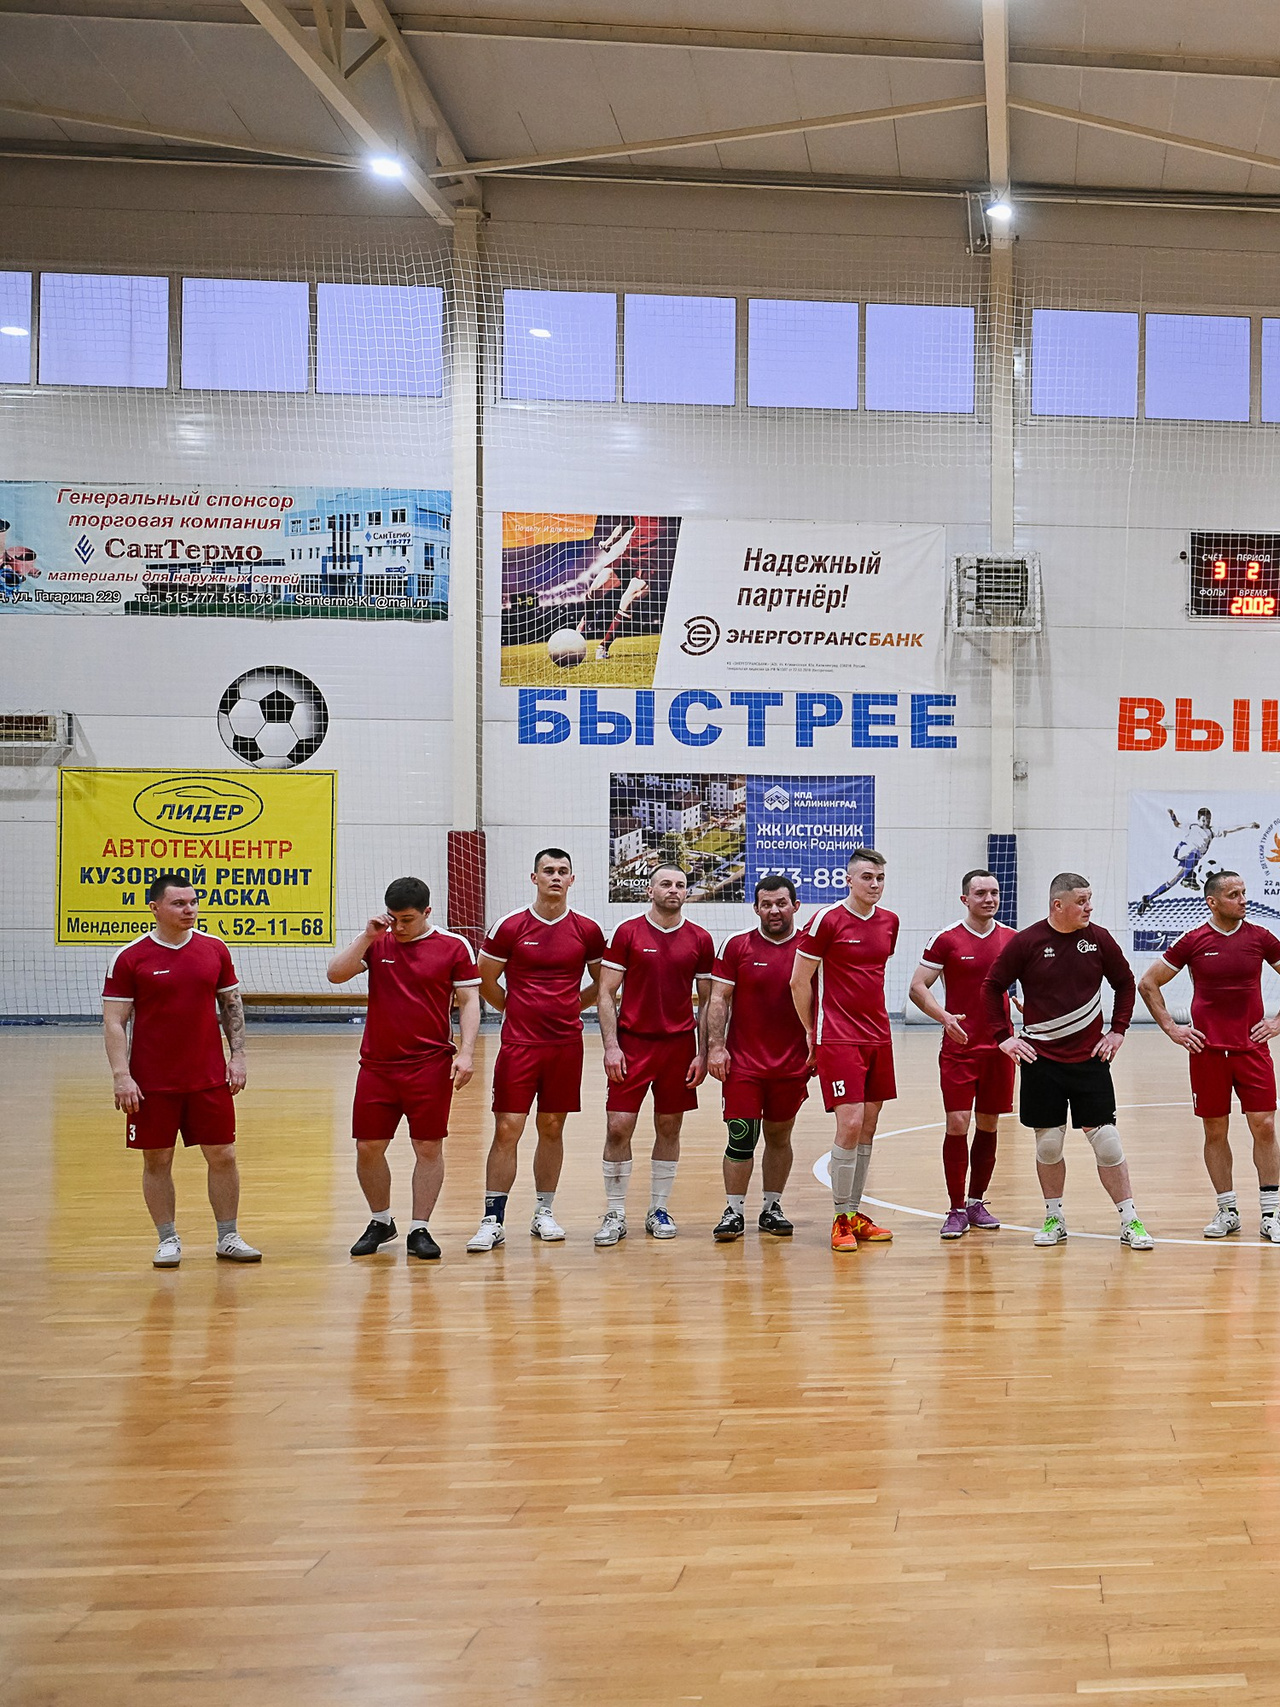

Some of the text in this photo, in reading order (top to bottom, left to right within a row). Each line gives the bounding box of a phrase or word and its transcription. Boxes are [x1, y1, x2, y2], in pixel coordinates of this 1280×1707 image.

[57, 488, 294, 511] Генеральный спонсор
[69, 515, 281, 530] торговая компания
[105, 538, 263, 566] СанТермо
[1237, 554, 1270, 562] ПЕРИОД
[743, 547, 881, 576] Надежный
[1214, 561, 1226, 579] 3
[1247, 562, 1260, 580] 2
[48, 570, 299, 586] материалы для наружных сетей
[13, 592, 32, 604] ул.
[35, 590, 94, 604] Гагарина
[96, 591, 121, 603] 229
[135, 593, 161, 603] тел.
[223, 593, 273, 604] 515-073
[295, 594, 428, 609] Santermo-KL@mail.ru
[737, 584, 849, 613] партнёр!
[1199, 589, 1226, 597] ФОЛЫ
[1239, 589, 1268, 597] ВРЕМЯ
[726, 629, 925, 648] ЭНЕРГОТРАНСБАНК
[517, 689, 957, 749] БЫСТРЕЕ
[156, 803, 244, 822] ЛИДЕР
[794, 800, 857, 809] КАЛИНИНГРАД
[757, 823, 863, 837] ЖК ИСТОЧНИК
[102, 838, 293, 861] АВТОТЕХЦЕНТР
[756, 838, 865, 851] поселок Родники
[216, 868, 312, 886] РЕМОНТ
[122, 888, 270, 906] и РАСКА
[233, 918, 324, 936] 52-11-68
[832, 1080, 846, 1097] 13
[129, 1124, 136, 1141] 3
